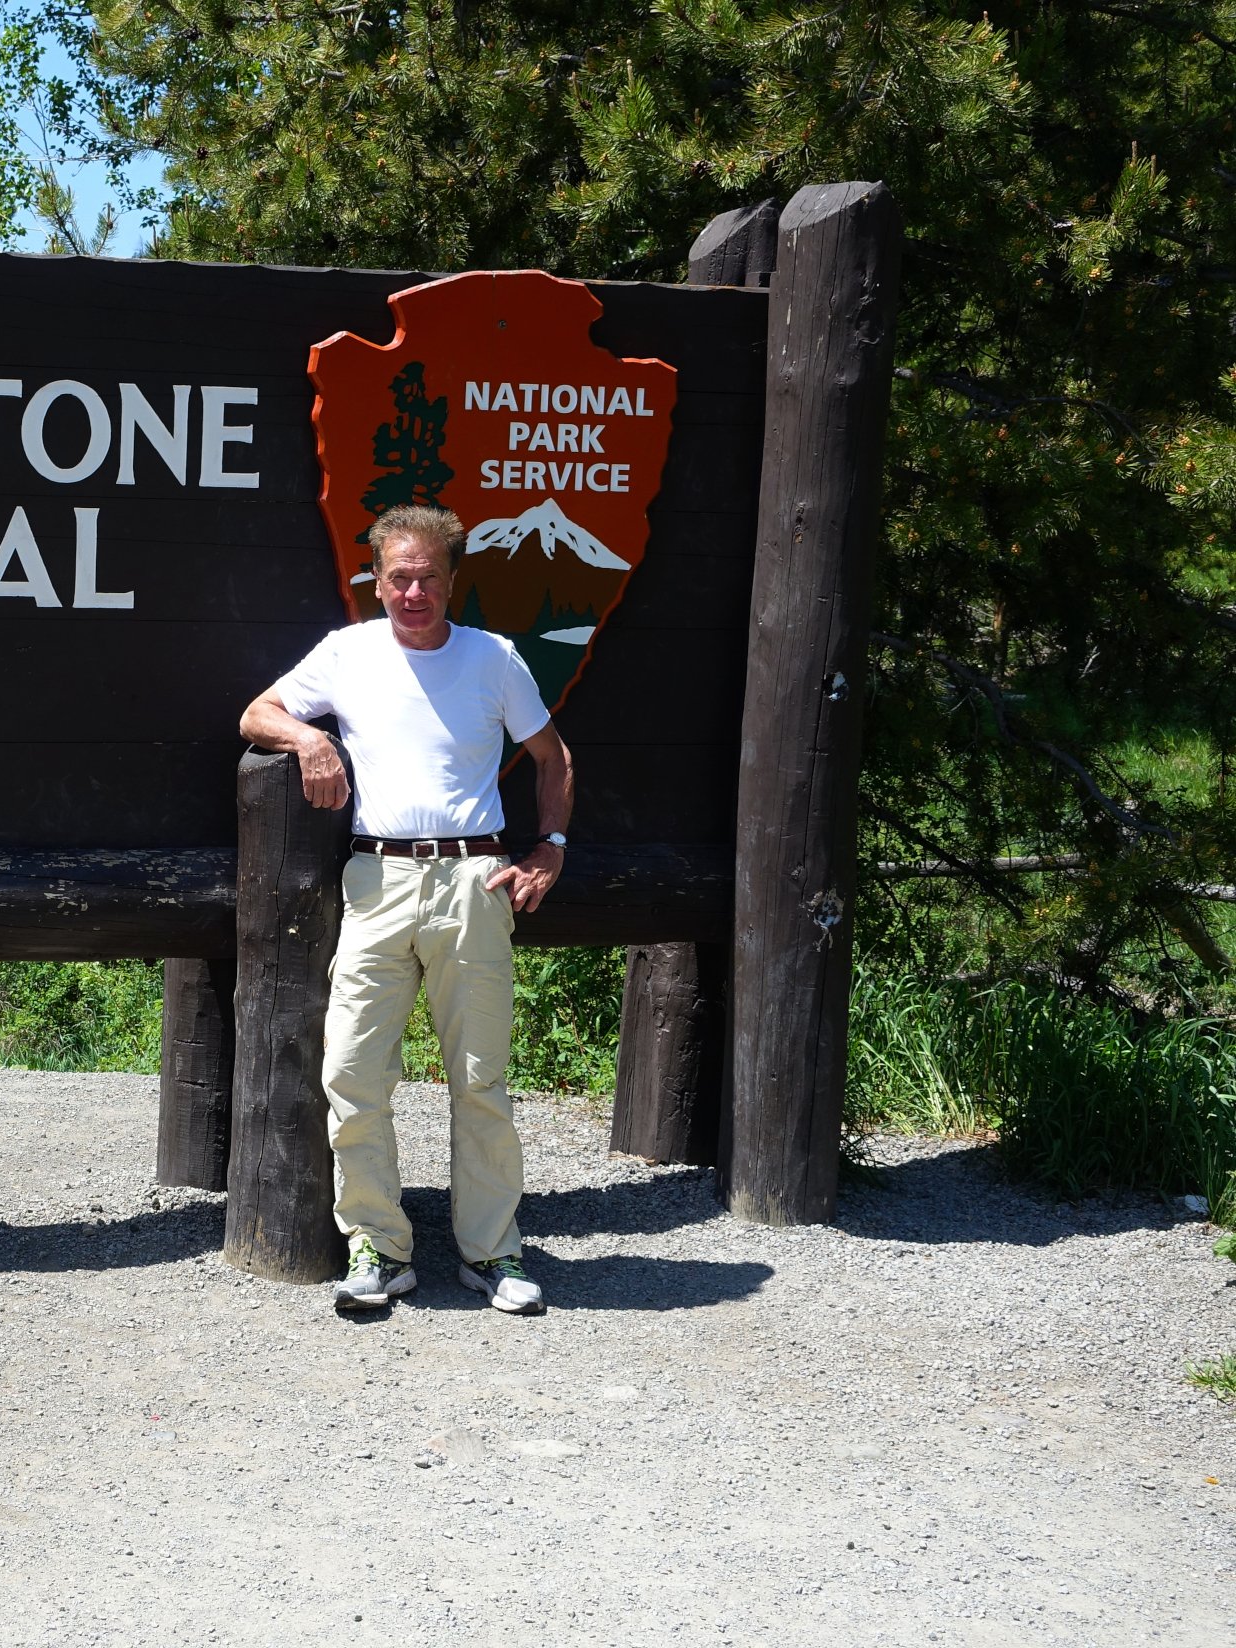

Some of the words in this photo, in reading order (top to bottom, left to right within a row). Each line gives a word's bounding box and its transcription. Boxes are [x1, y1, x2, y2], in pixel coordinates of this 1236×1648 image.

[464, 381, 654, 417] NATIONAL
[508, 422, 606, 454] PARK
[480, 459, 630, 493] SERVICE
